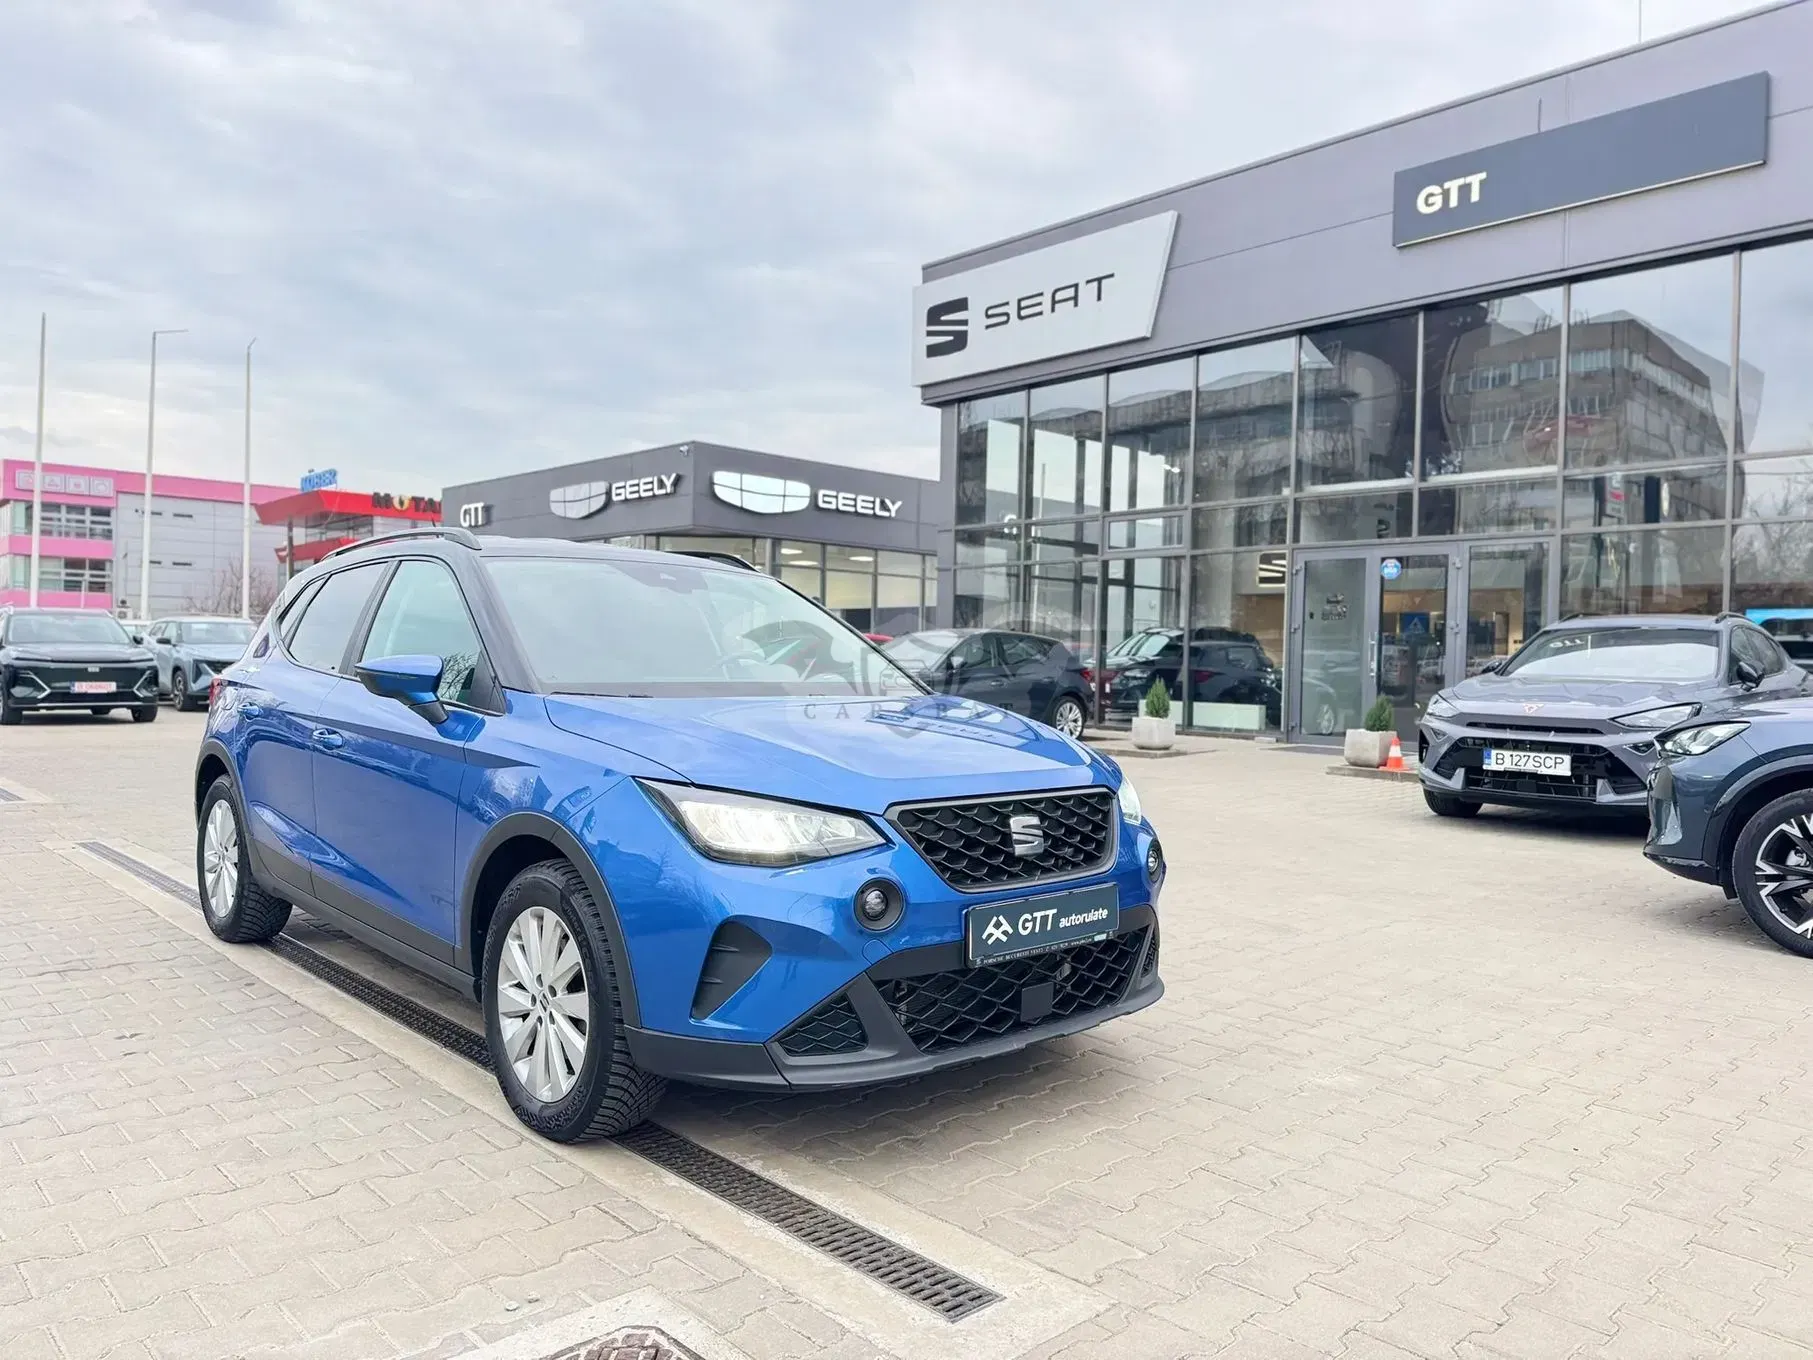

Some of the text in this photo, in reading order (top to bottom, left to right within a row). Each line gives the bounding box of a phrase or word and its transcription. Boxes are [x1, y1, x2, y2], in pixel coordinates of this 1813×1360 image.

[1416, 171, 1487, 214] GTT
[984, 272, 1115, 330] SEAT
[611, 472, 677, 502] GEELY
[460, 501, 485, 528] GTT
[817, 488, 903, 518] GEELY
[1495, 752, 1506, 766] B
[1017, 907, 1109, 936] GTT autorulate
